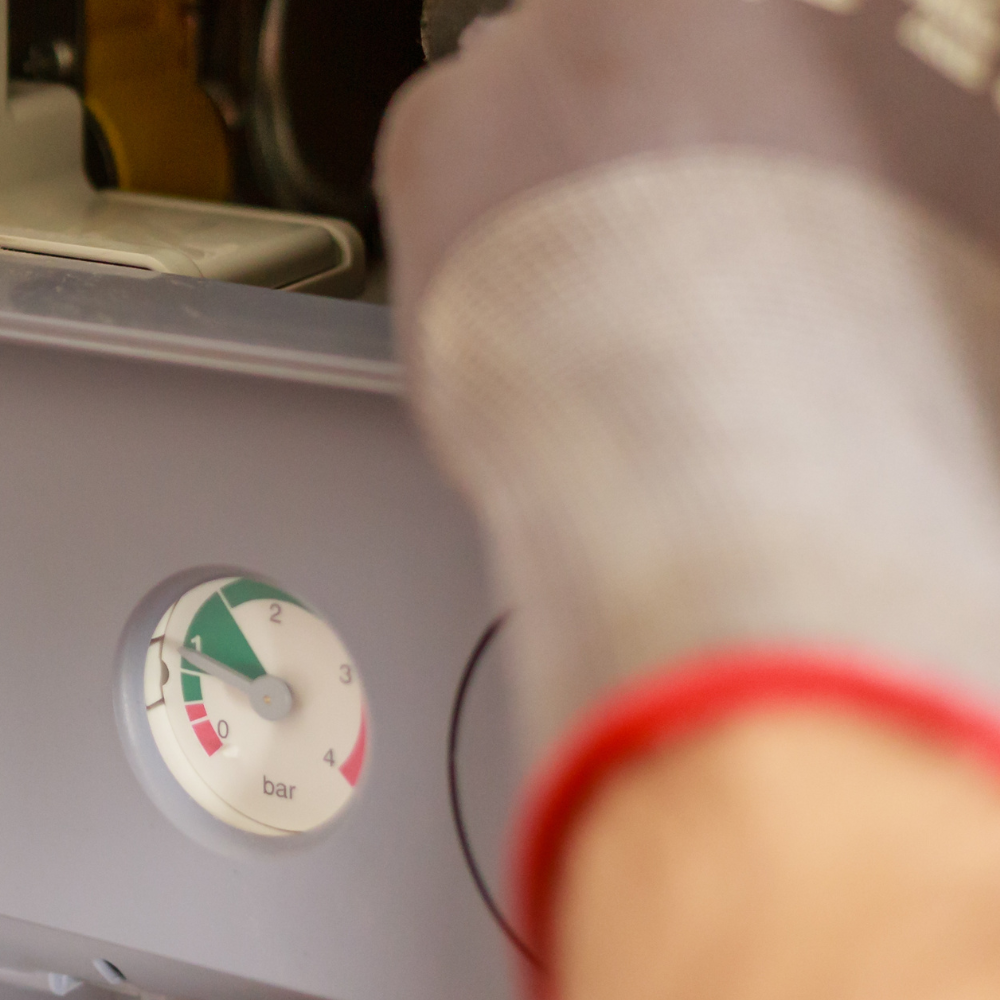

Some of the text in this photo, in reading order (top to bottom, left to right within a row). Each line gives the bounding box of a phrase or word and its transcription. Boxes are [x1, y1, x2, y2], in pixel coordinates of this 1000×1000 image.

[269, 602, 283, 625] 2
[190, 634, 203, 651] 1
[338, 663, 352, 685] 3
[216, 719, 230, 739] 0
[322, 748, 336, 768] 4
[262, 775, 296, 800] bar
